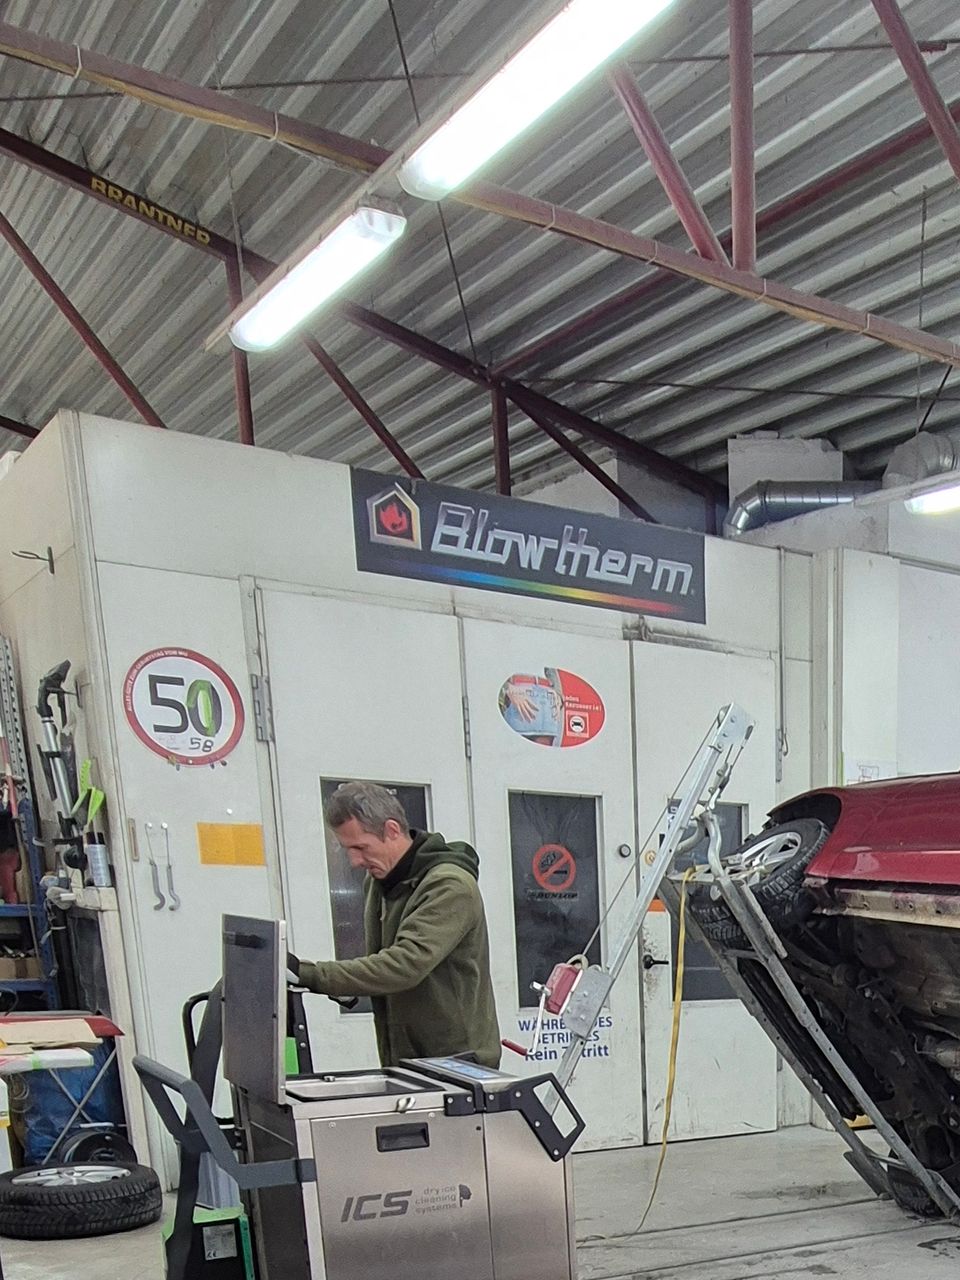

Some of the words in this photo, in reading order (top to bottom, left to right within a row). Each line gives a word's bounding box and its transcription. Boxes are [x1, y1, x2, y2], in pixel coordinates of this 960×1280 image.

[431, 501, 694, 596] Blowtherm
[148, 674, 223, 737] 50
[189, 737, 214, 752] 58
[341, 1190, 413, 1222] ICS
